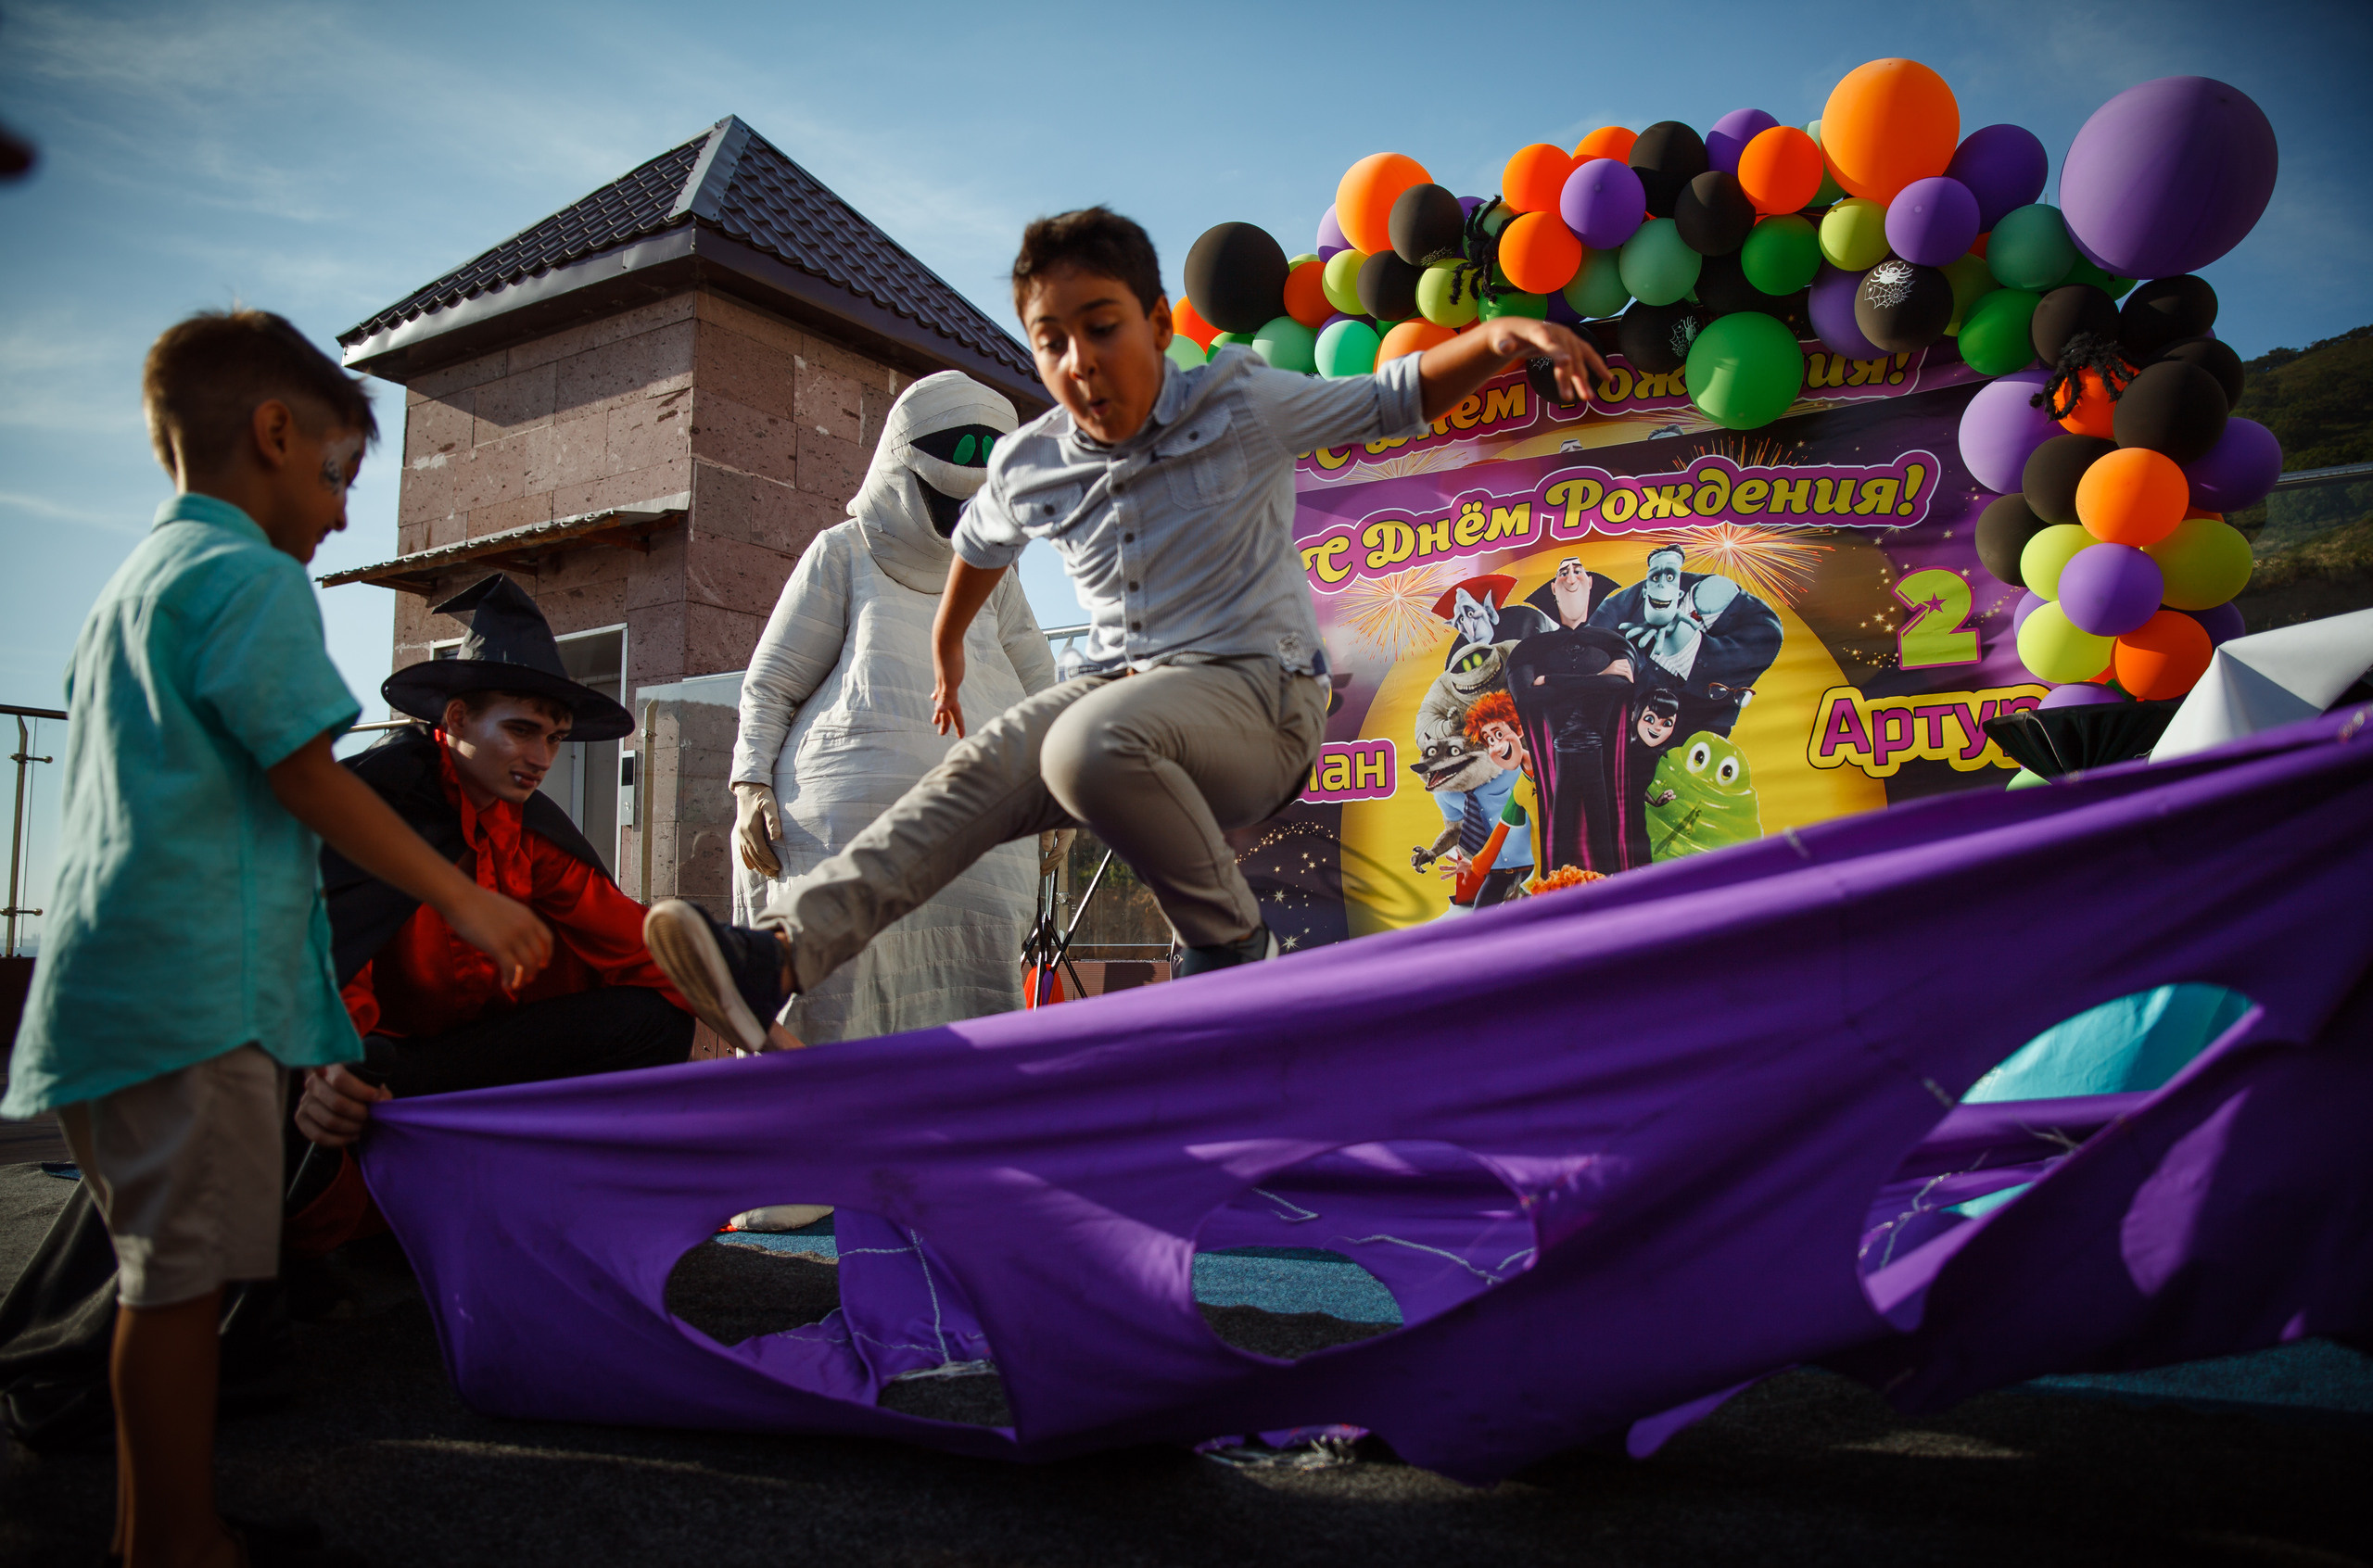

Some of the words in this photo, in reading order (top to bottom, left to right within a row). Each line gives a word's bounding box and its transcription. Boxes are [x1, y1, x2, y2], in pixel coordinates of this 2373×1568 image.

[1299, 535, 1352, 584] С
[1362, 499, 1532, 569] Днём
[1544, 463, 1926, 528] Рождения!
[1891, 565, 1982, 670] 2
